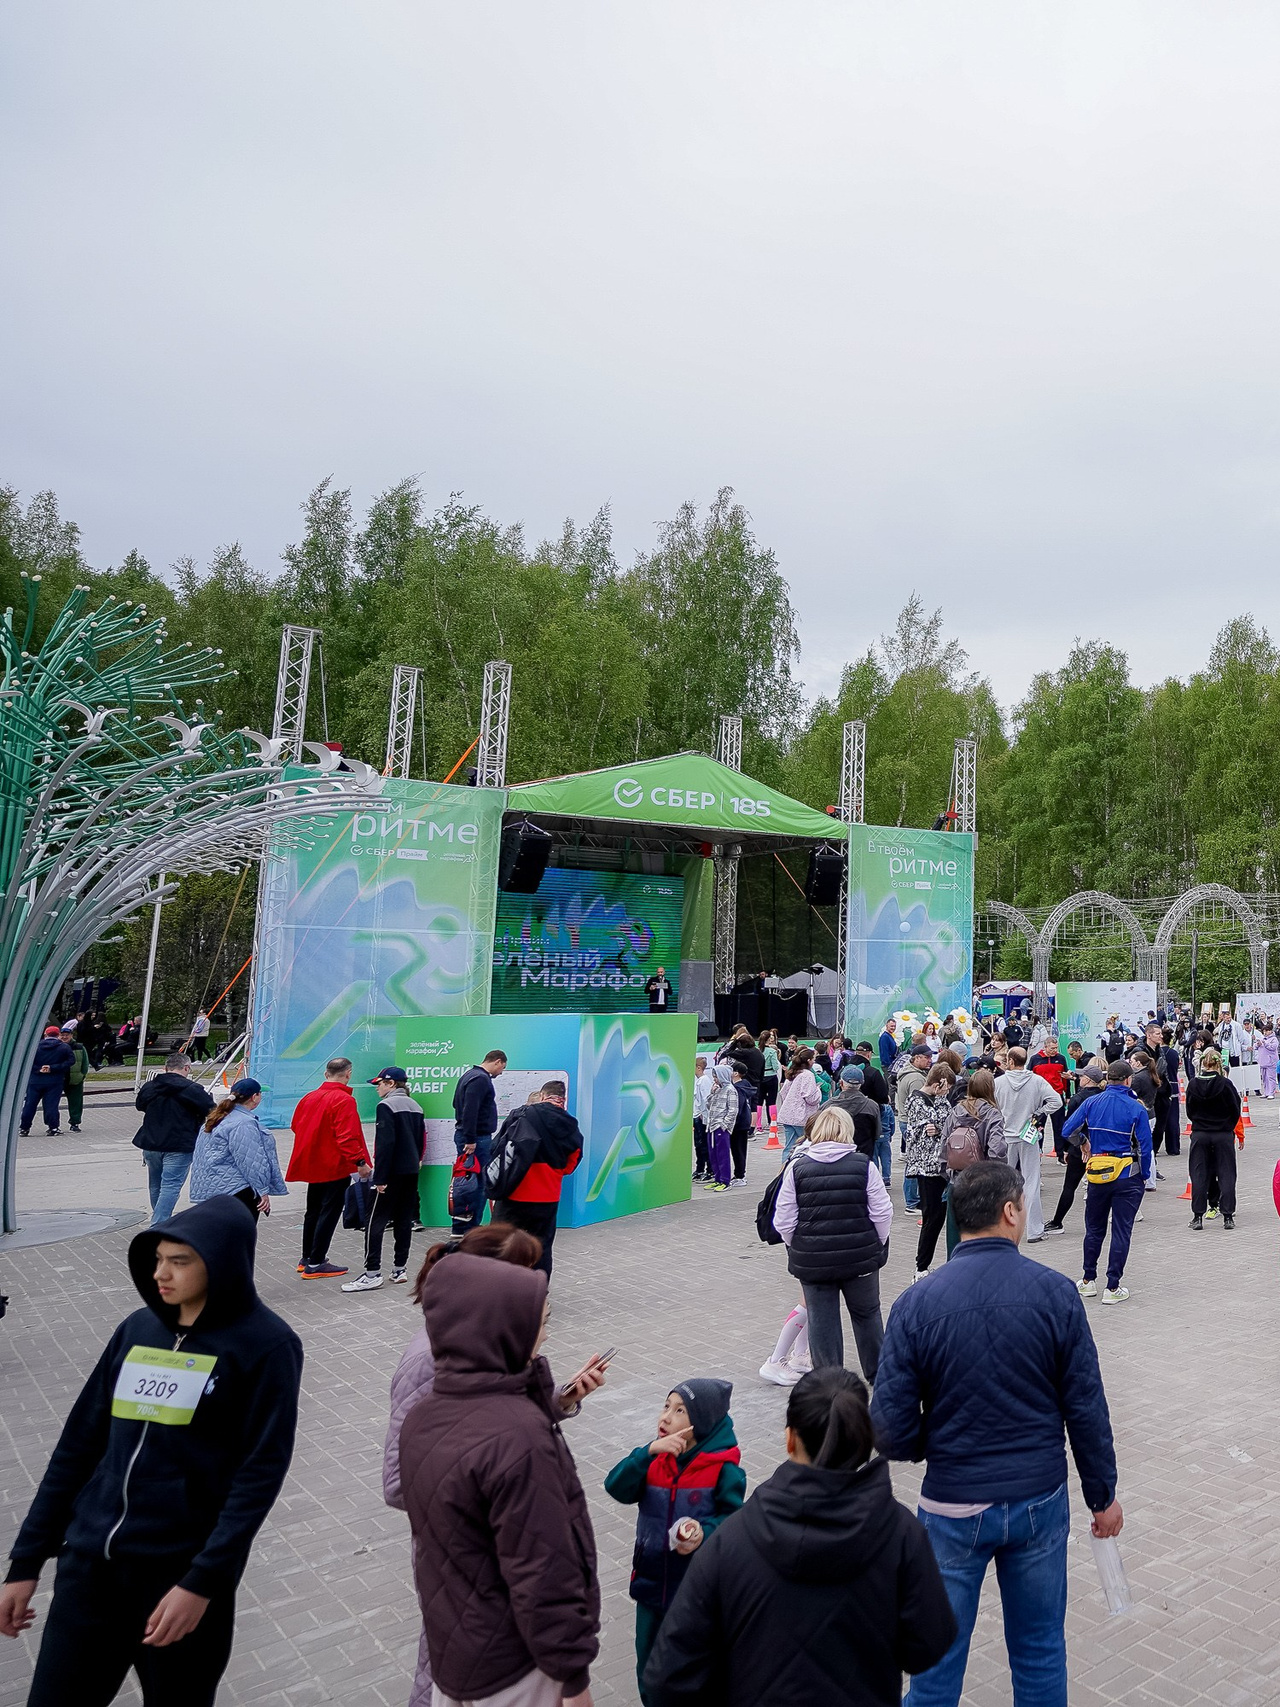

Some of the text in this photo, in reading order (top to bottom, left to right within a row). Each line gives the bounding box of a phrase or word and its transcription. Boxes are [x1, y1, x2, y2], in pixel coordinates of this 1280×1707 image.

[650, 787, 771, 817] СБЕР 185
[351, 814, 479, 844] ритме
[366, 848, 395, 857] СБЕР
[878, 844, 915, 857] твоём
[889, 857, 957, 878] ритме
[493, 948, 601, 967] елёный
[520, 968, 652, 992] Марафо
[134, 1379, 178, 1400] 3209
